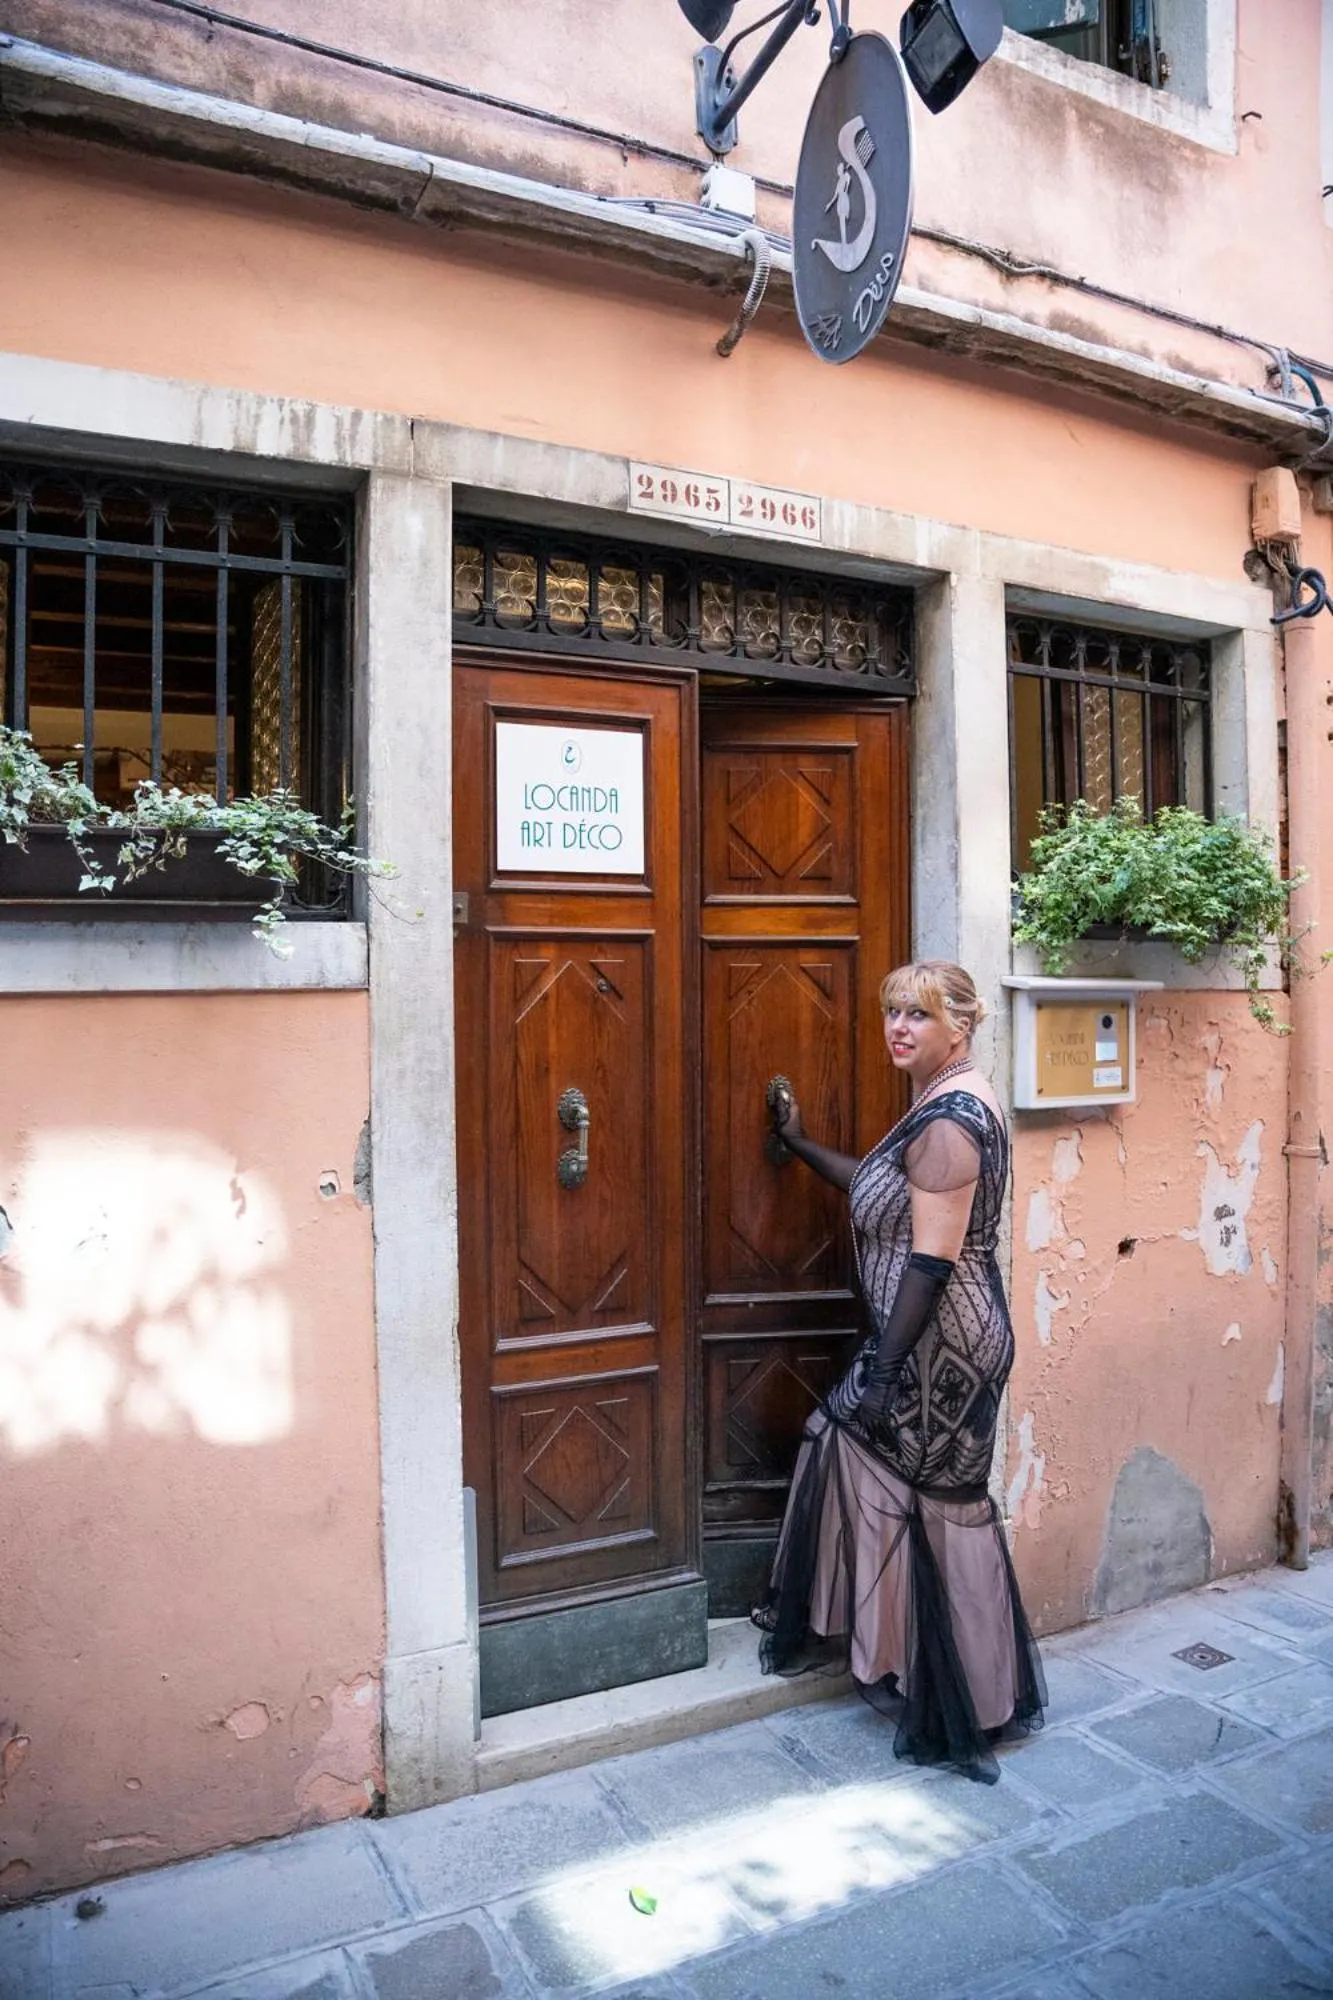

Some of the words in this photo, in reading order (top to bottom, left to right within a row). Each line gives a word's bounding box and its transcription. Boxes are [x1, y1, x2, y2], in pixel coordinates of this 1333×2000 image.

[637, 473, 721, 512] 2965
[738, 495, 816, 530] 2966
[524, 783, 619, 814] LOCANDA
[520, 820, 553, 848] ART
[562, 819, 623, 851] DÉCO
